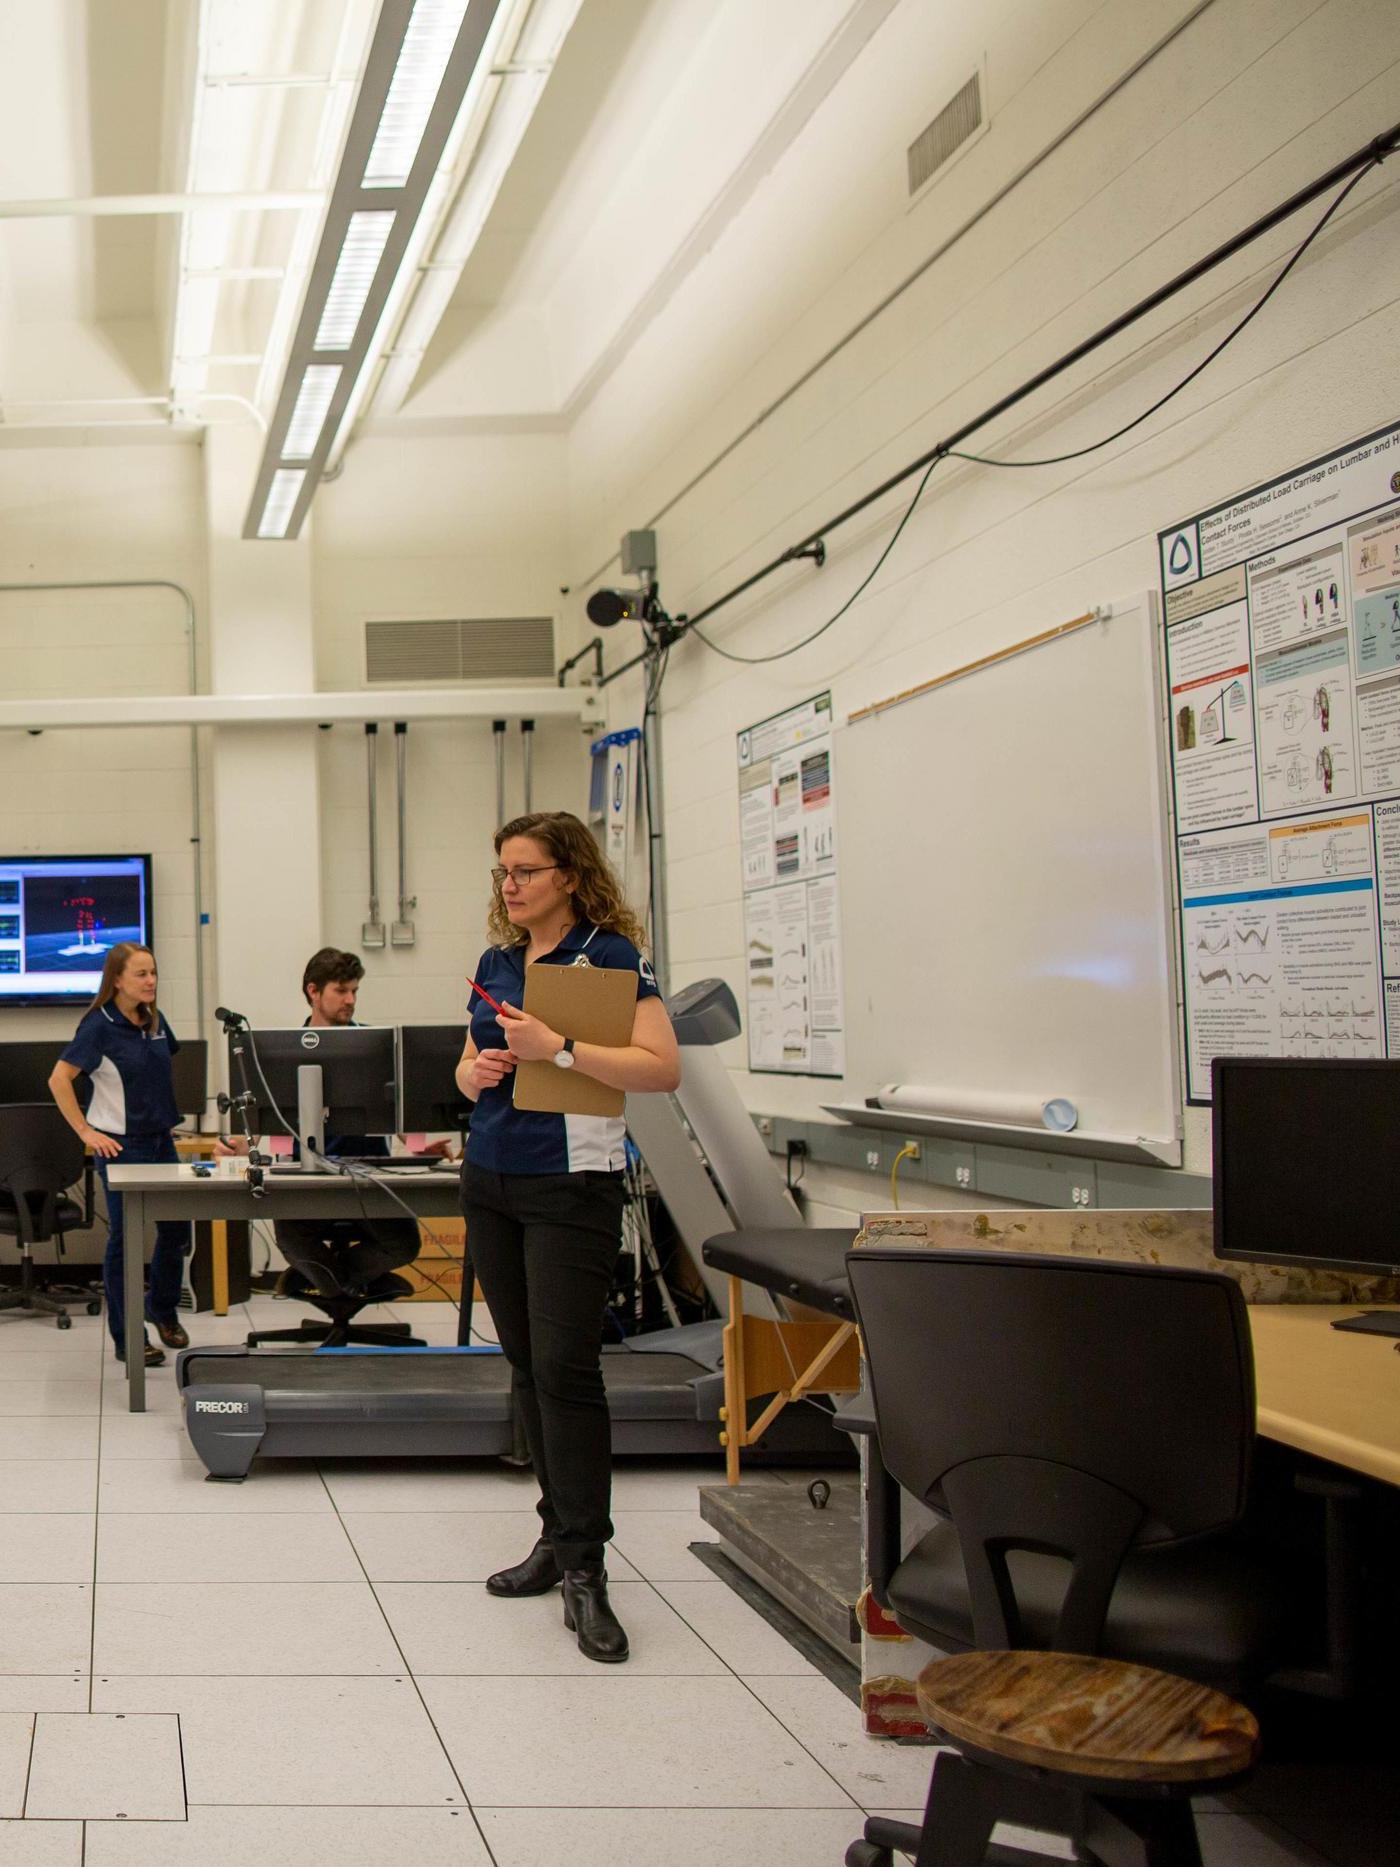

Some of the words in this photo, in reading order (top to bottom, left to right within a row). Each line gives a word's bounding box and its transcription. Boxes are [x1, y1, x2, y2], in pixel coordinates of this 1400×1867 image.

[1200, 515, 1223, 532] Effects
[1224, 510, 1232, 521] of
[1232, 492, 1272, 519] Distributed
[1272, 484, 1292, 500] Load
[1293, 470, 1326, 491] Carriage
[1328, 464, 1338, 476] on
[1340, 447, 1372, 470] Lumbar
[1374, 440, 1390, 454] and
[1201, 526, 1226, 545] Contact
[1228, 518, 1252, 536] Forces
[1248, 556, 1276, 572] Methods
[196, 1401, 242, 1414] PRECOR
